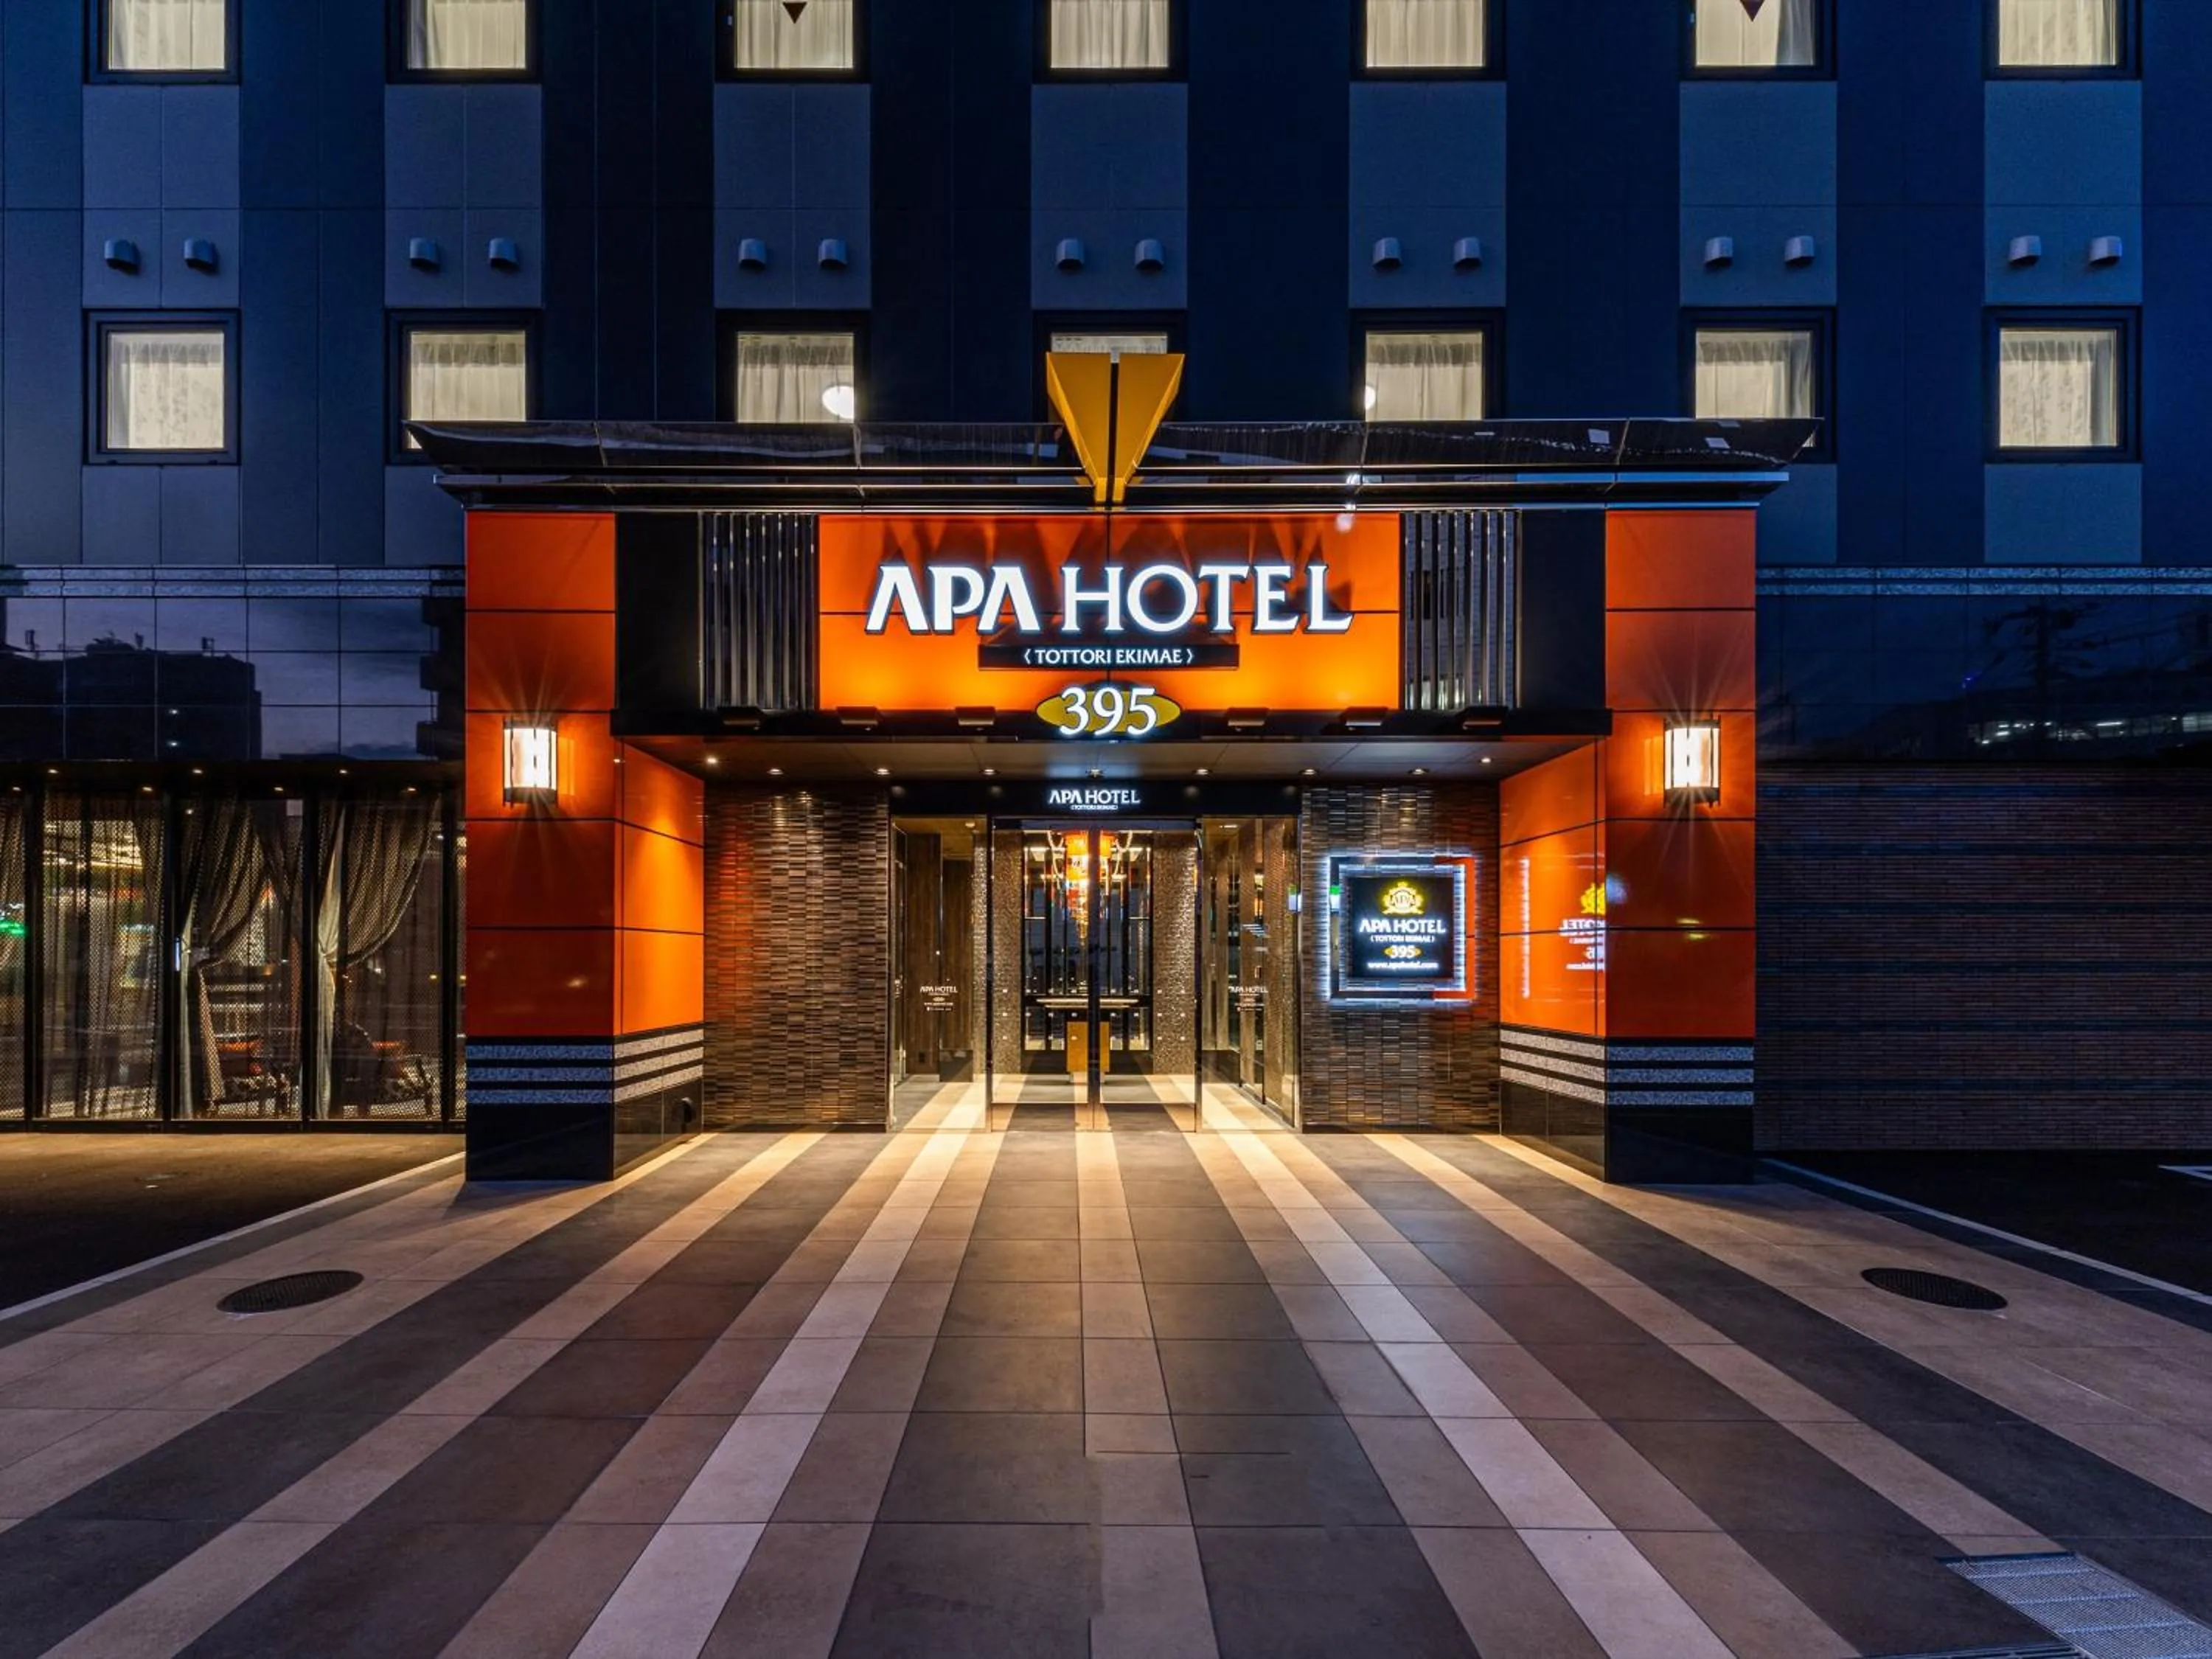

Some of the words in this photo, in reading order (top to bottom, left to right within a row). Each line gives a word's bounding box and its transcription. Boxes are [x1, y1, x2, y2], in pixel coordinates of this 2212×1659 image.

[865, 566, 1041, 632] APA
[1061, 564, 1354, 633] HOTEL
[1059, 686, 1157, 736] 395
[1049, 790, 1082, 804] APA
[1085, 790, 1141, 804] HOTEL
[1359, 919, 1391, 933] APA
[1393, 919, 1447, 933] HOTEL
[1389, 945, 1416, 959] 395
